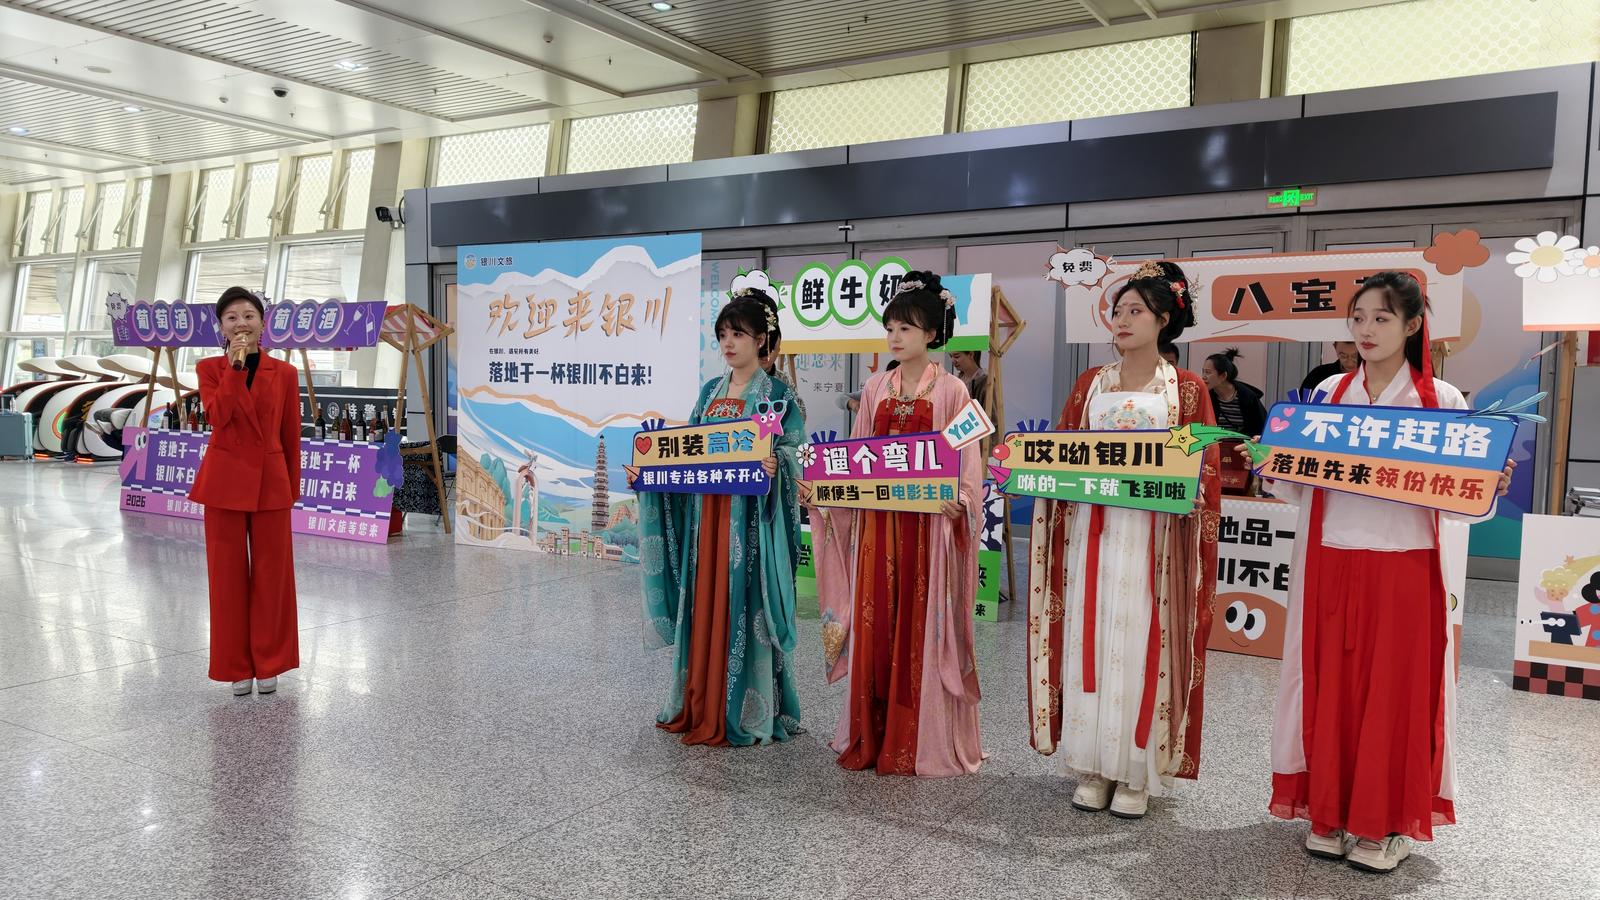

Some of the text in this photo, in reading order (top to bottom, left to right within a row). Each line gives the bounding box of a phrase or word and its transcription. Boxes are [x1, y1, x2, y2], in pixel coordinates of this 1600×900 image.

[480, 256, 513, 267] 银川文旅
[1062, 260, 1092, 273] 免费
[711, 261, 720, 327] WELCOME
[1228, 276, 1372, 315] 八宝
[136, 308, 188, 330] 葡萄酒
[274, 307, 338, 330] 葡萄酒
[485, 286, 673, 342] 欢迎来银川
[813, 382, 844, 393] 来宁夏
[657, 428, 756, 459] 别装高冷
[1301, 411, 1492, 459] 不许赶路
[822, 439, 943, 477] 遛个弯儿
[642, 468, 765, 486] 银川专治各种不开心
[1270, 452, 1485, 500] 落地先来领份快乐
[126, 494, 146, 508] 2026
[816, 483, 954, 501] 顺便当一回电影主角
[308, 516, 379, 538] 银川文旅等您来
